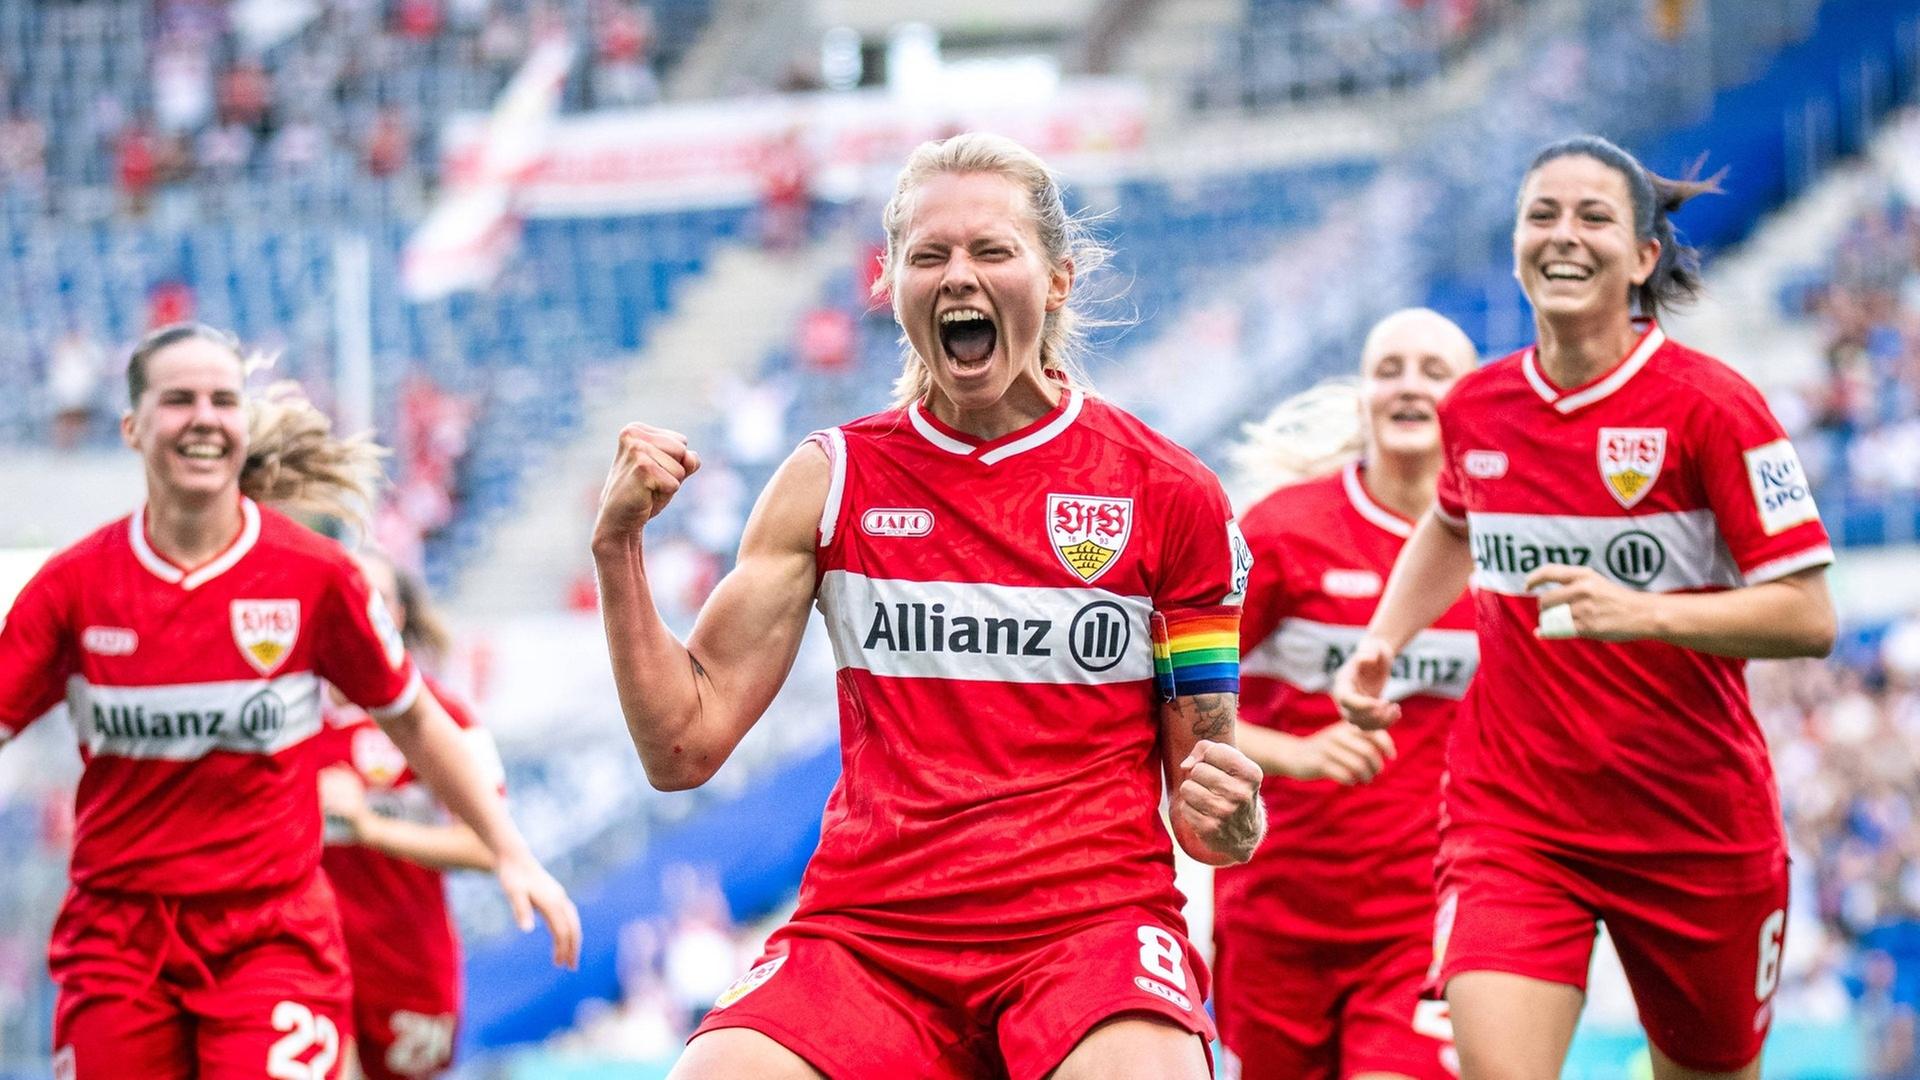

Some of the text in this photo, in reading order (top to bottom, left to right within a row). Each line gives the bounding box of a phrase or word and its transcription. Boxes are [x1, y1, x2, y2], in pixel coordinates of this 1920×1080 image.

[1764, 485, 1812, 511] SPO
[868, 515, 928, 530] JAKO
[863, 601, 1052, 656] Allianz
[1322, 644, 1463, 683] Aanz
[93, 701, 225, 739] Allianz
[1137, 925, 1187, 991] 8
[1755, 908, 1785, 1001] 6
